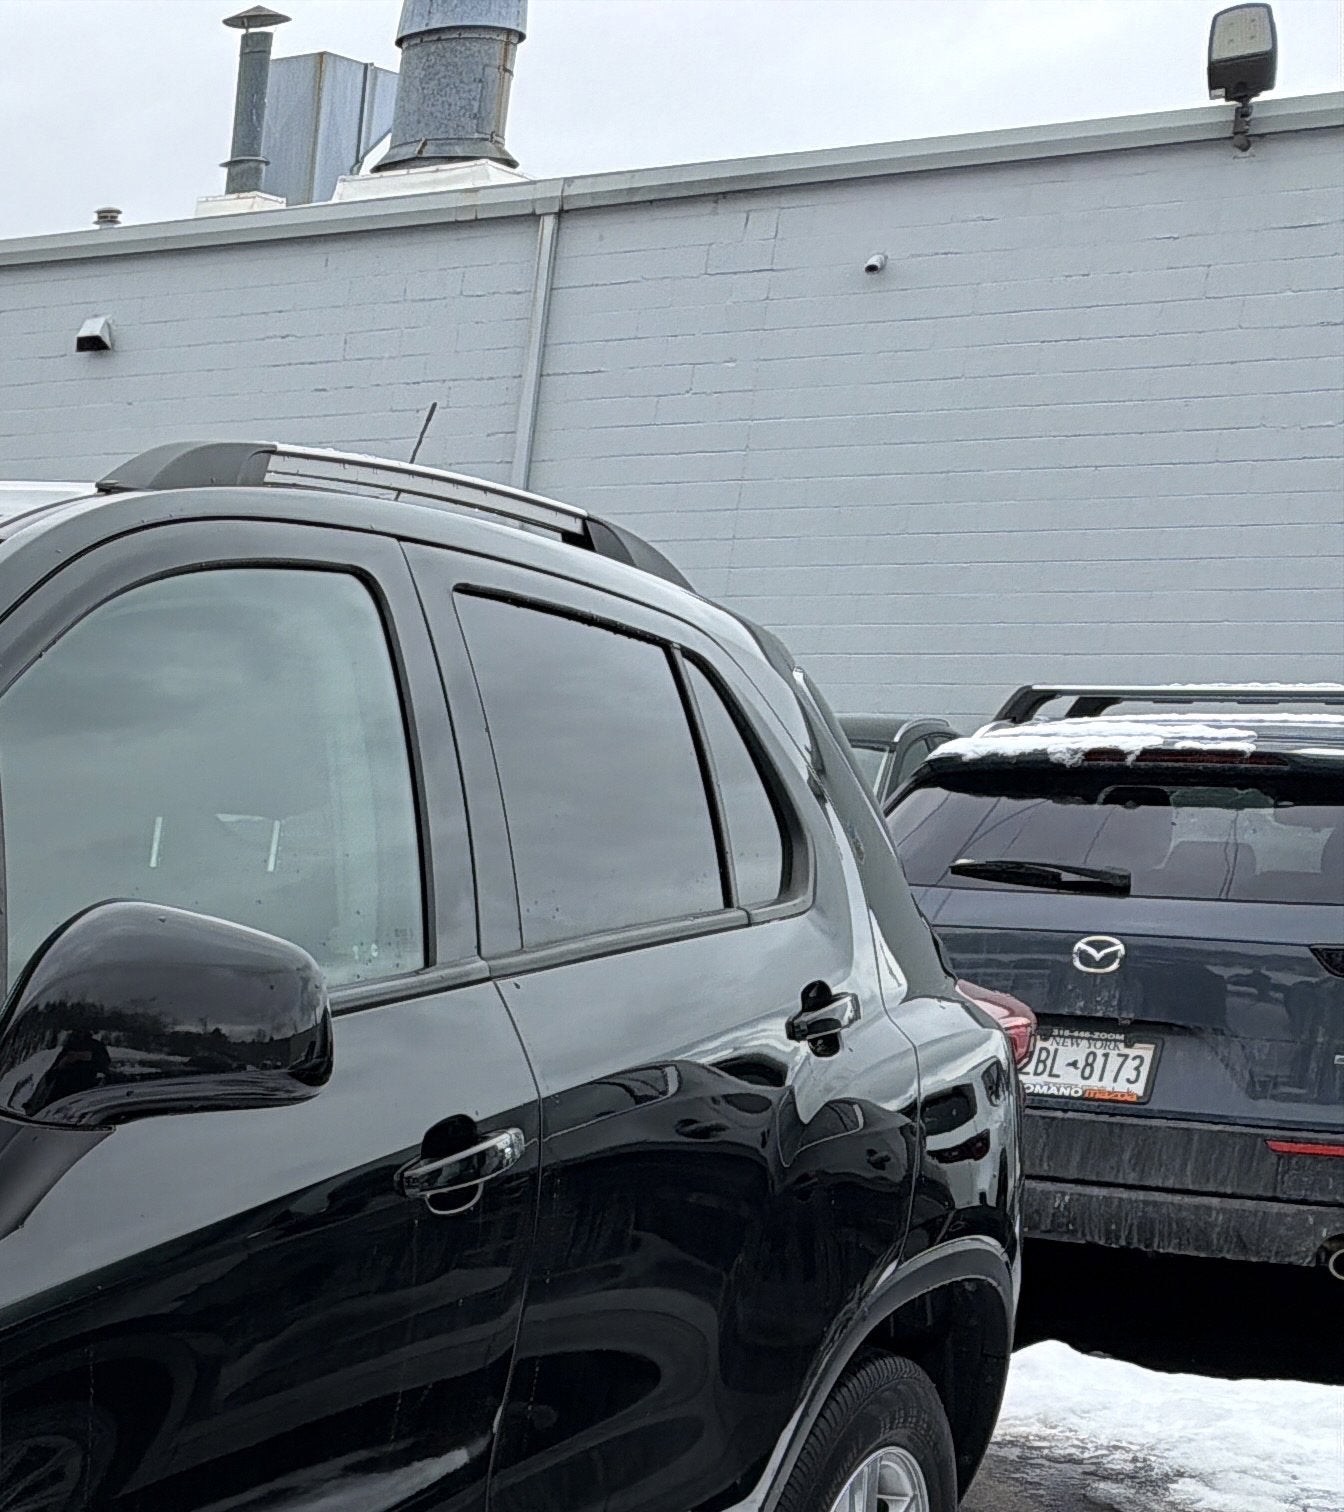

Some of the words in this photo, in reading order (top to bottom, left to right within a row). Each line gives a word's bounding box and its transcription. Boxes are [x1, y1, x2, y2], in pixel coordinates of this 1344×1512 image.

[1050, 1037, 1082, 1049] NEW
[1086, 1039, 1121, 1052] YORK
[1018, 1046, 1061, 1078] BL
[1081, 1050, 1145, 1085] 8173
[1023, 1083, 1083, 1097] OMANO
